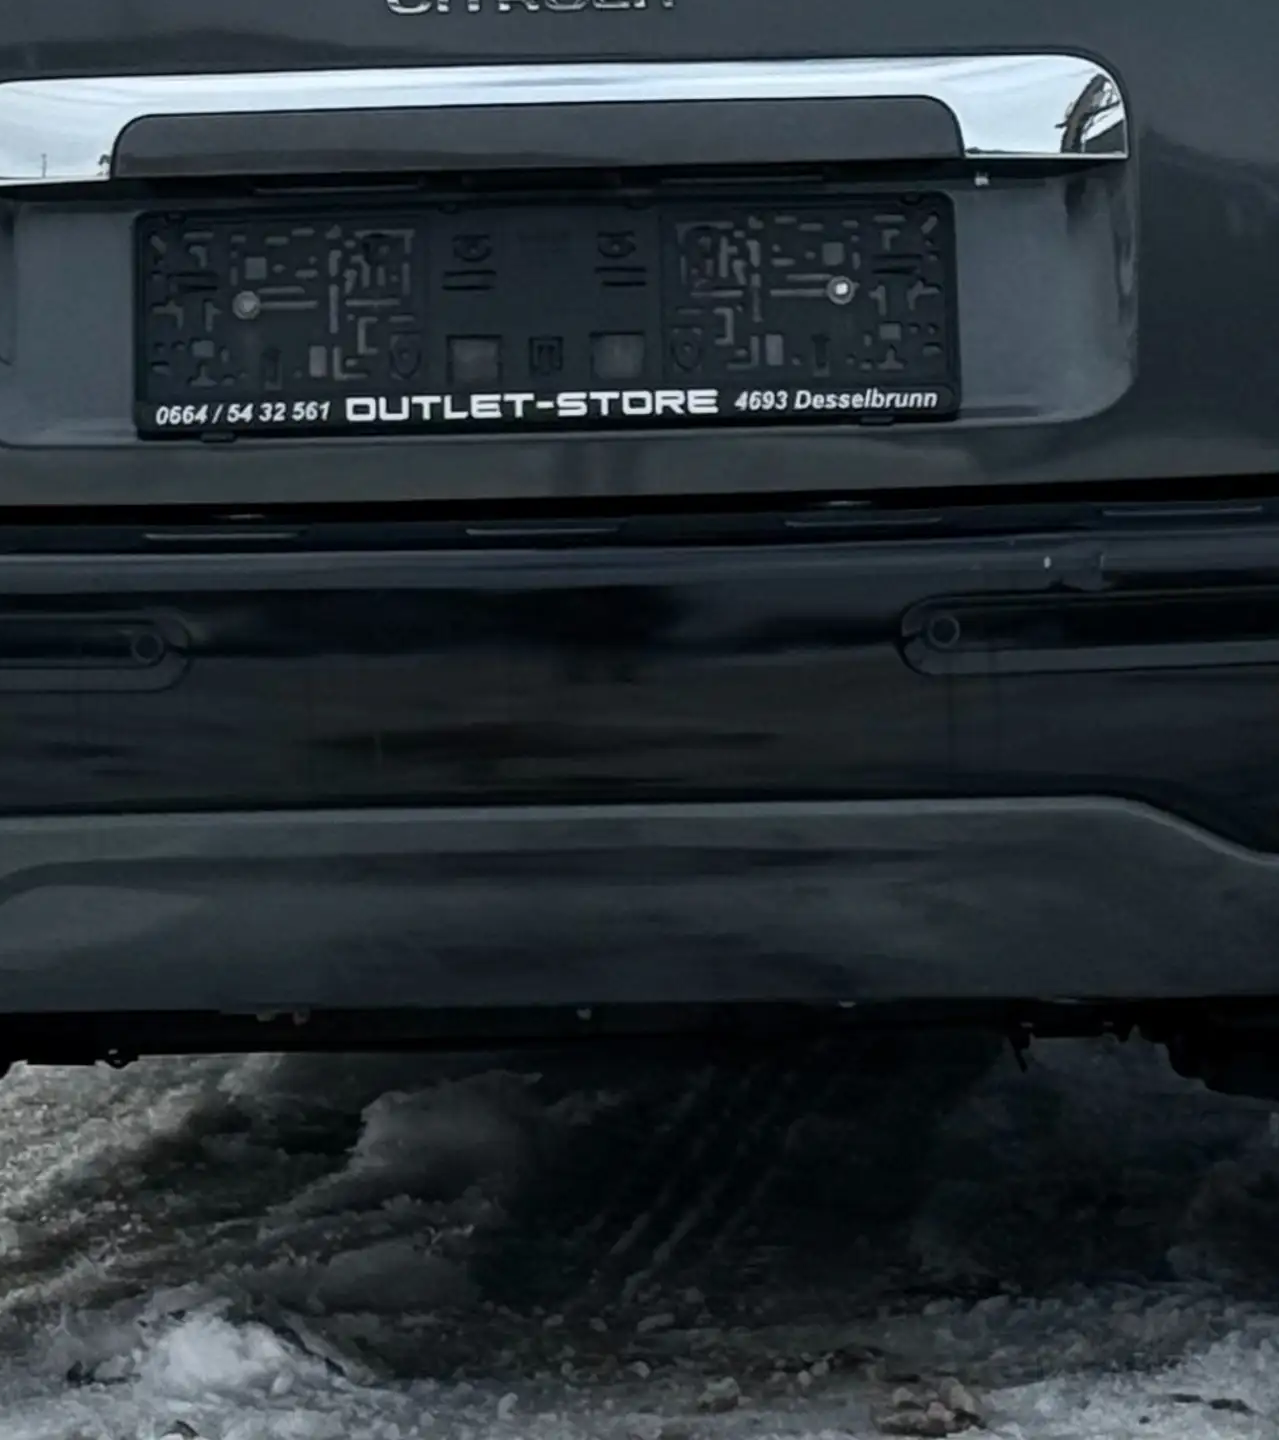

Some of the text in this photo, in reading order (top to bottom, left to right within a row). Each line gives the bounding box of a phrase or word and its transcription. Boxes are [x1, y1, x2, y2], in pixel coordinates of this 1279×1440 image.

[155, 404, 209, 426] 0664
[226, 403, 253, 423] 54
[258, 402, 286, 422] 32
[291, 401, 331, 421] 561
[345, 389, 719, 422] OUTLET-STORE
[734, 391, 789, 411] 4693
[794, 388, 938, 410] Desselbrunn
